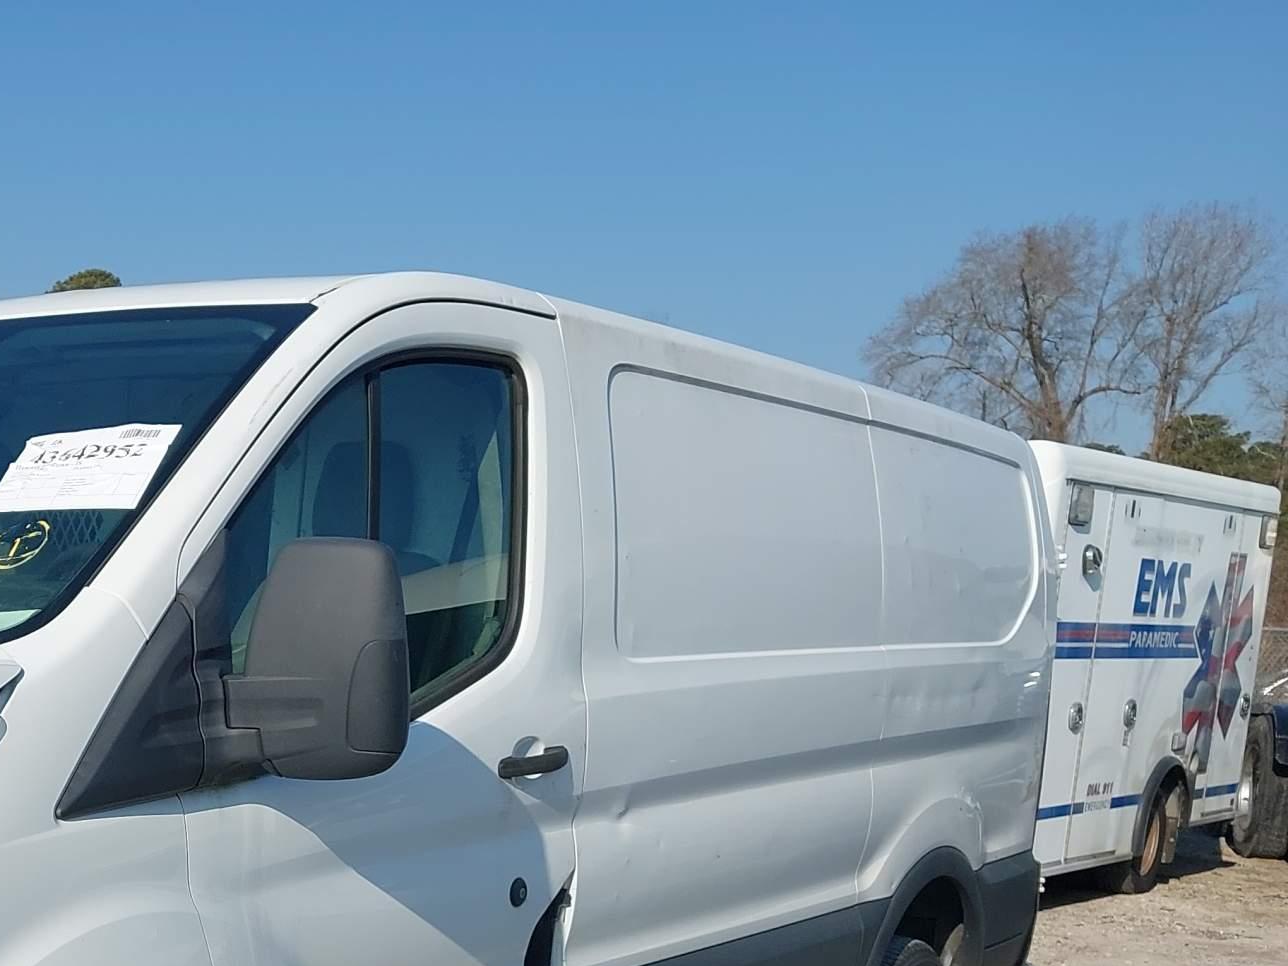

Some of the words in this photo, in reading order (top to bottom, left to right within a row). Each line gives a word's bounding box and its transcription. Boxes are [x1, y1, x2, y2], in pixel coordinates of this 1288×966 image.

[30, 443, 148, 464] 43642952
[1133, 558, 1192, 618] EMS
[1129, 630, 1179, 649] PARAMEDIC
